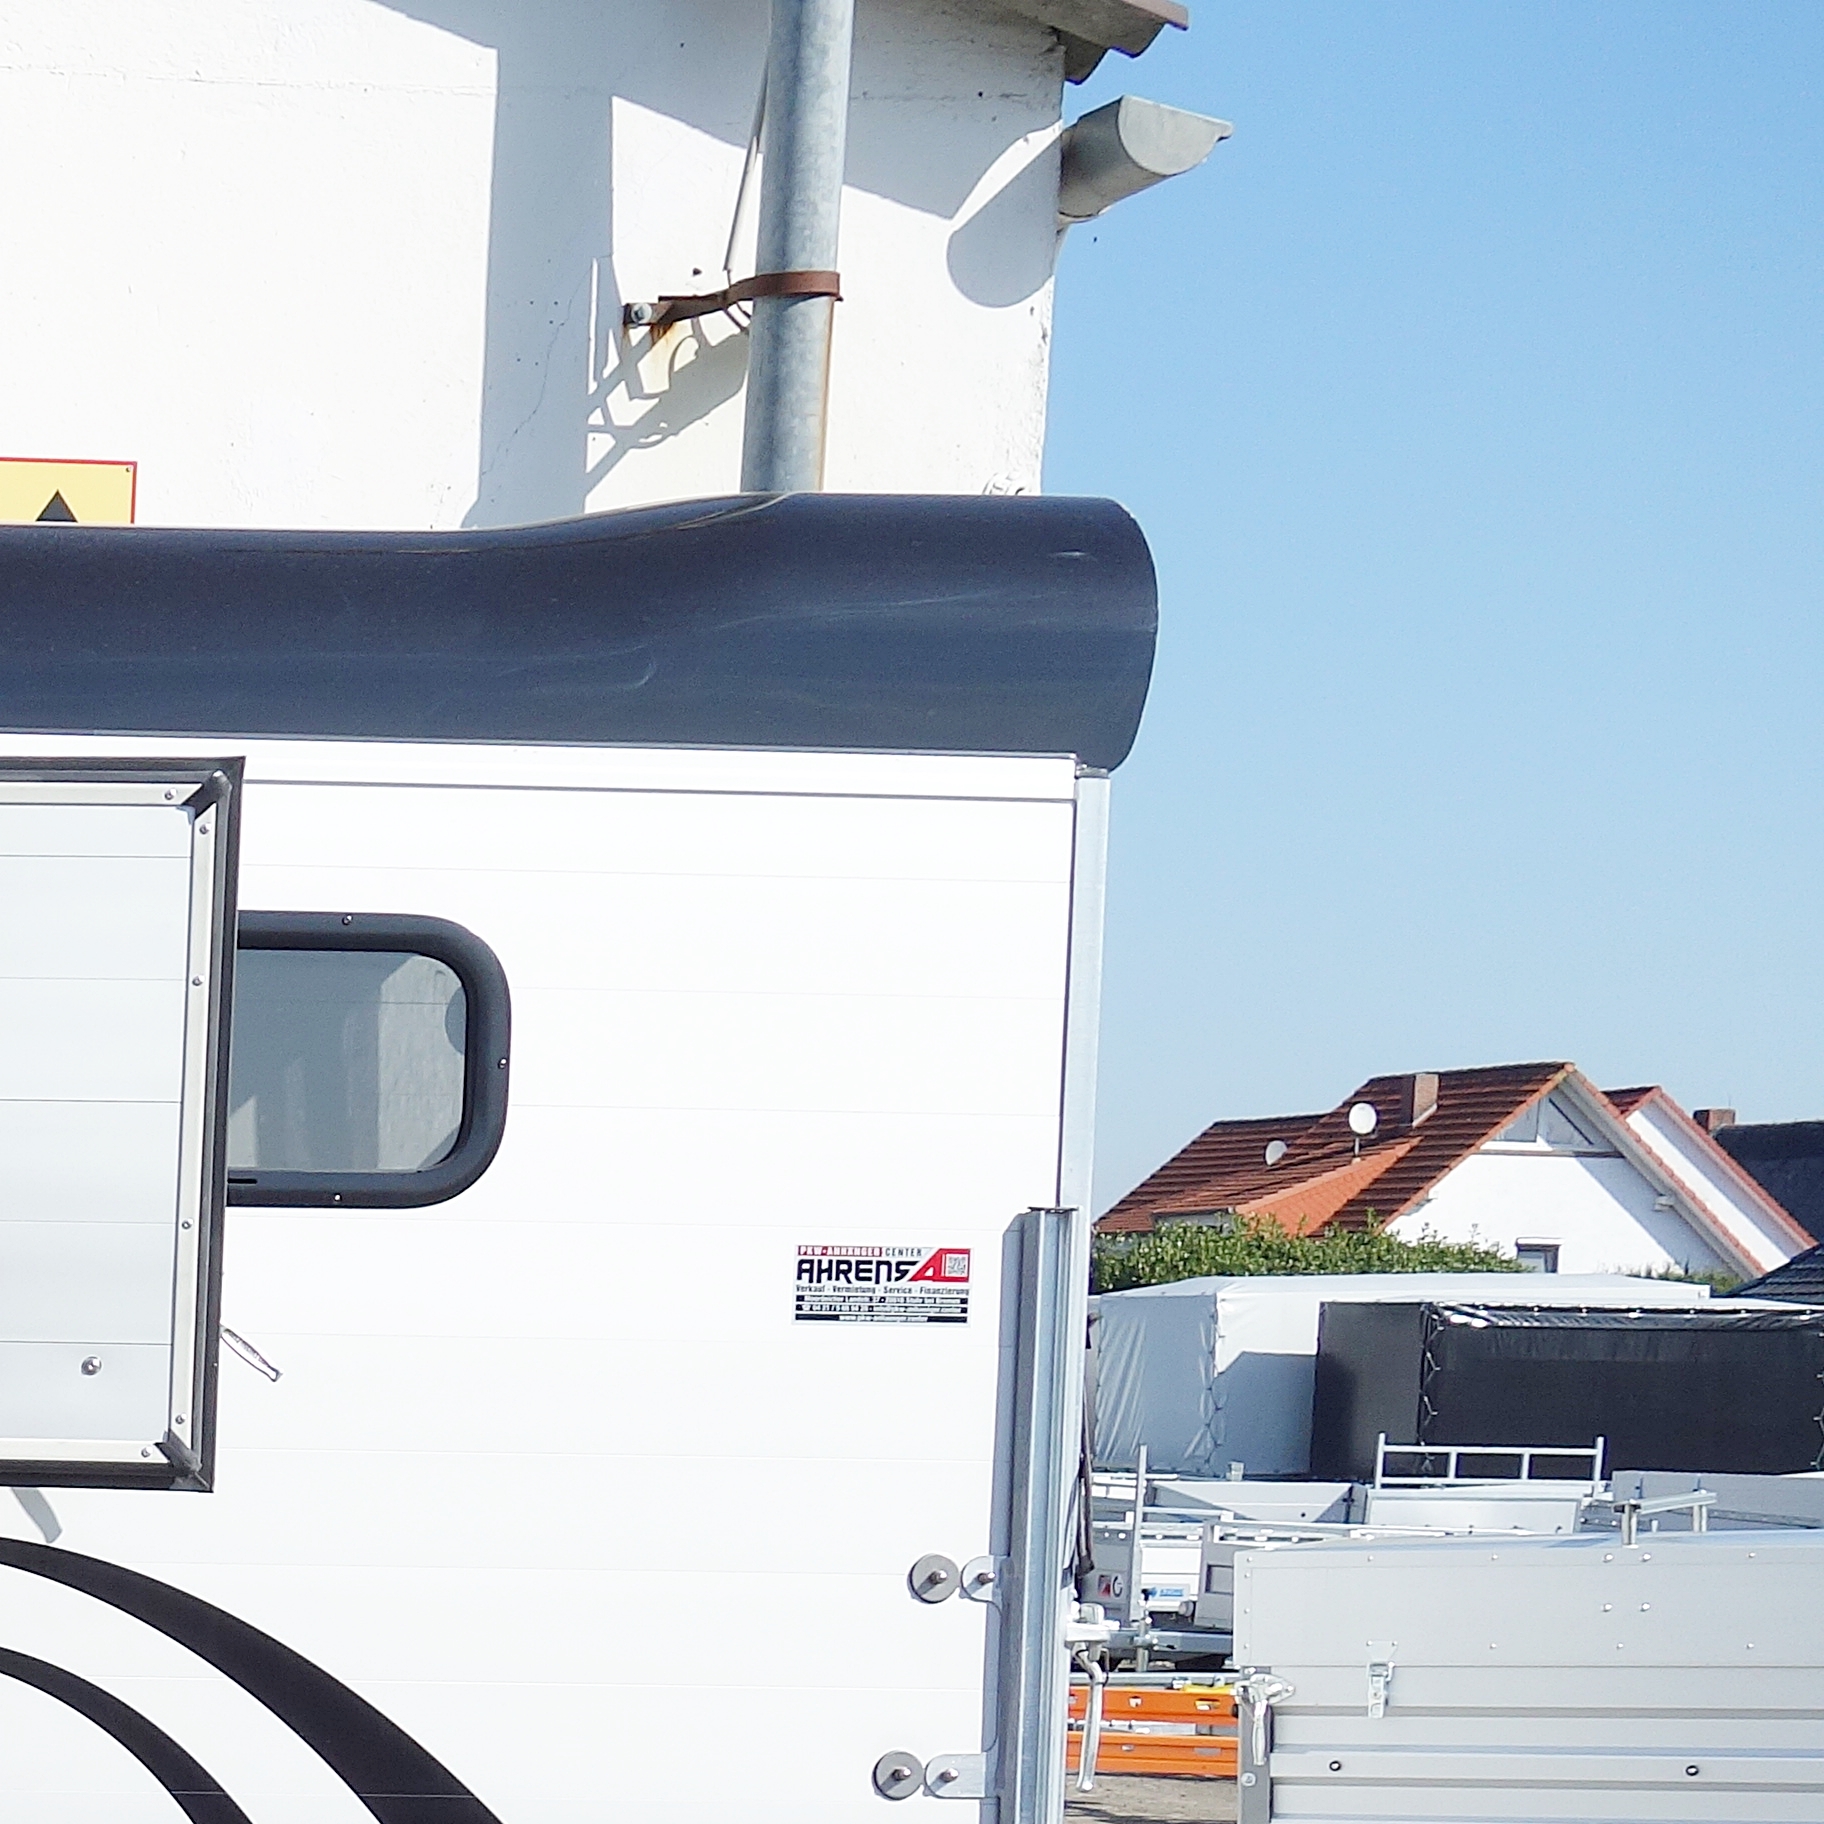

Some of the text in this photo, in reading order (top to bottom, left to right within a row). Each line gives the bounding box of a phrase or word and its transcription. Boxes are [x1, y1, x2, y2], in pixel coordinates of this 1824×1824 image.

[885, 1247, 922, 1257] CENTER
[797, 1259, 920, 1285] AHRENS
[796, 1284, 826, 1293] Verkauf
[883, 1286, 913, 1294] Service
[919, 1286, 970, 1296] Finanzierung
